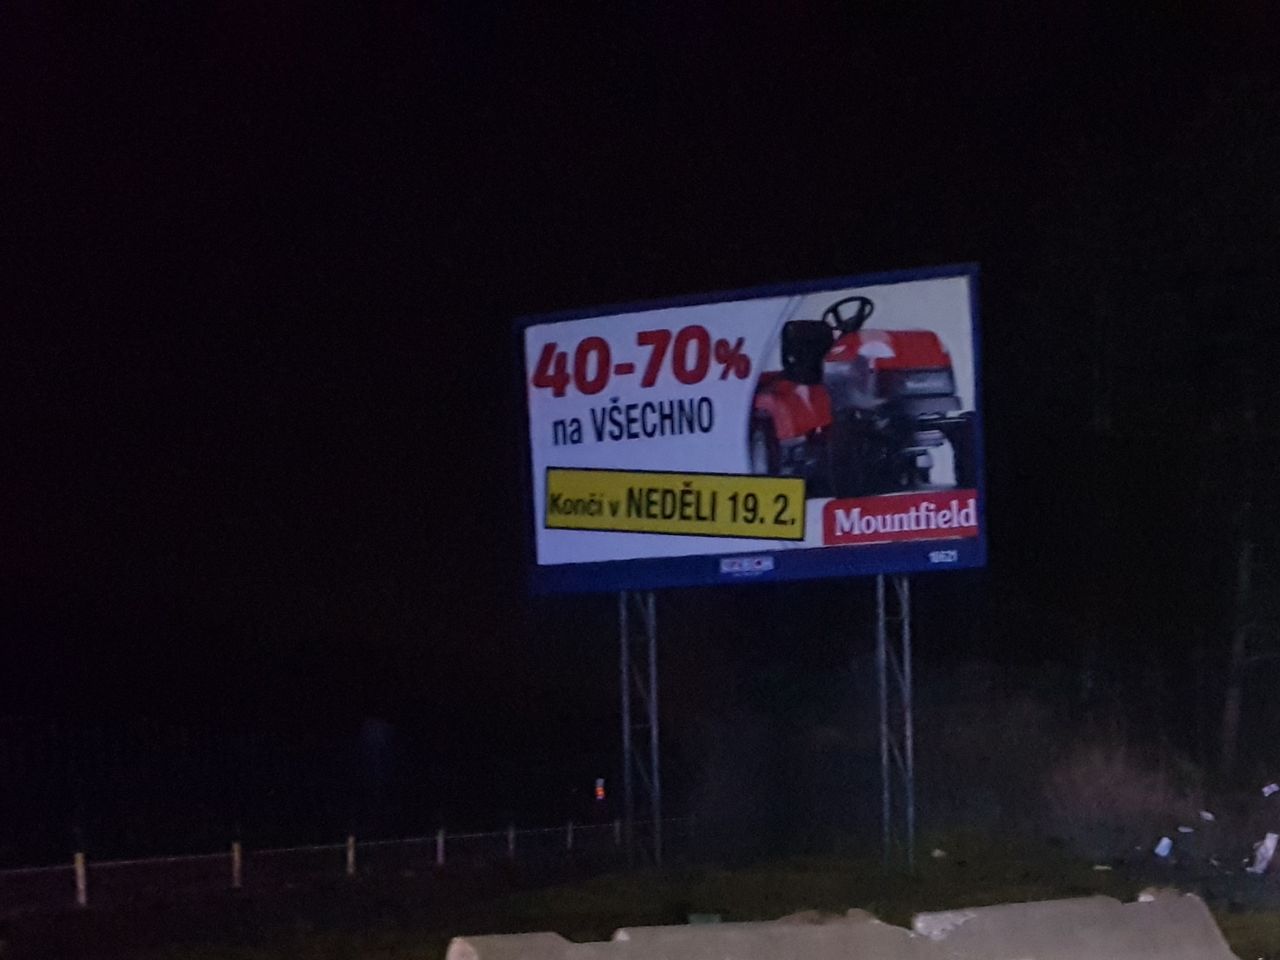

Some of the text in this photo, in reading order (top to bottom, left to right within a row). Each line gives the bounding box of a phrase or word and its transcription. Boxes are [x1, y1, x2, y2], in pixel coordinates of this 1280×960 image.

[532, 325, 751, 397] 40-70%
[553, 397, 714, 446] na VŠECHNO
[608, 500, 620, 517] v
[626, 481, 716, 522] NEDĚLI
[728, 493, 765, 524] 19.
[773, 493, 796, 525] 2.
[834, 499, 977, 536] Mountfield
